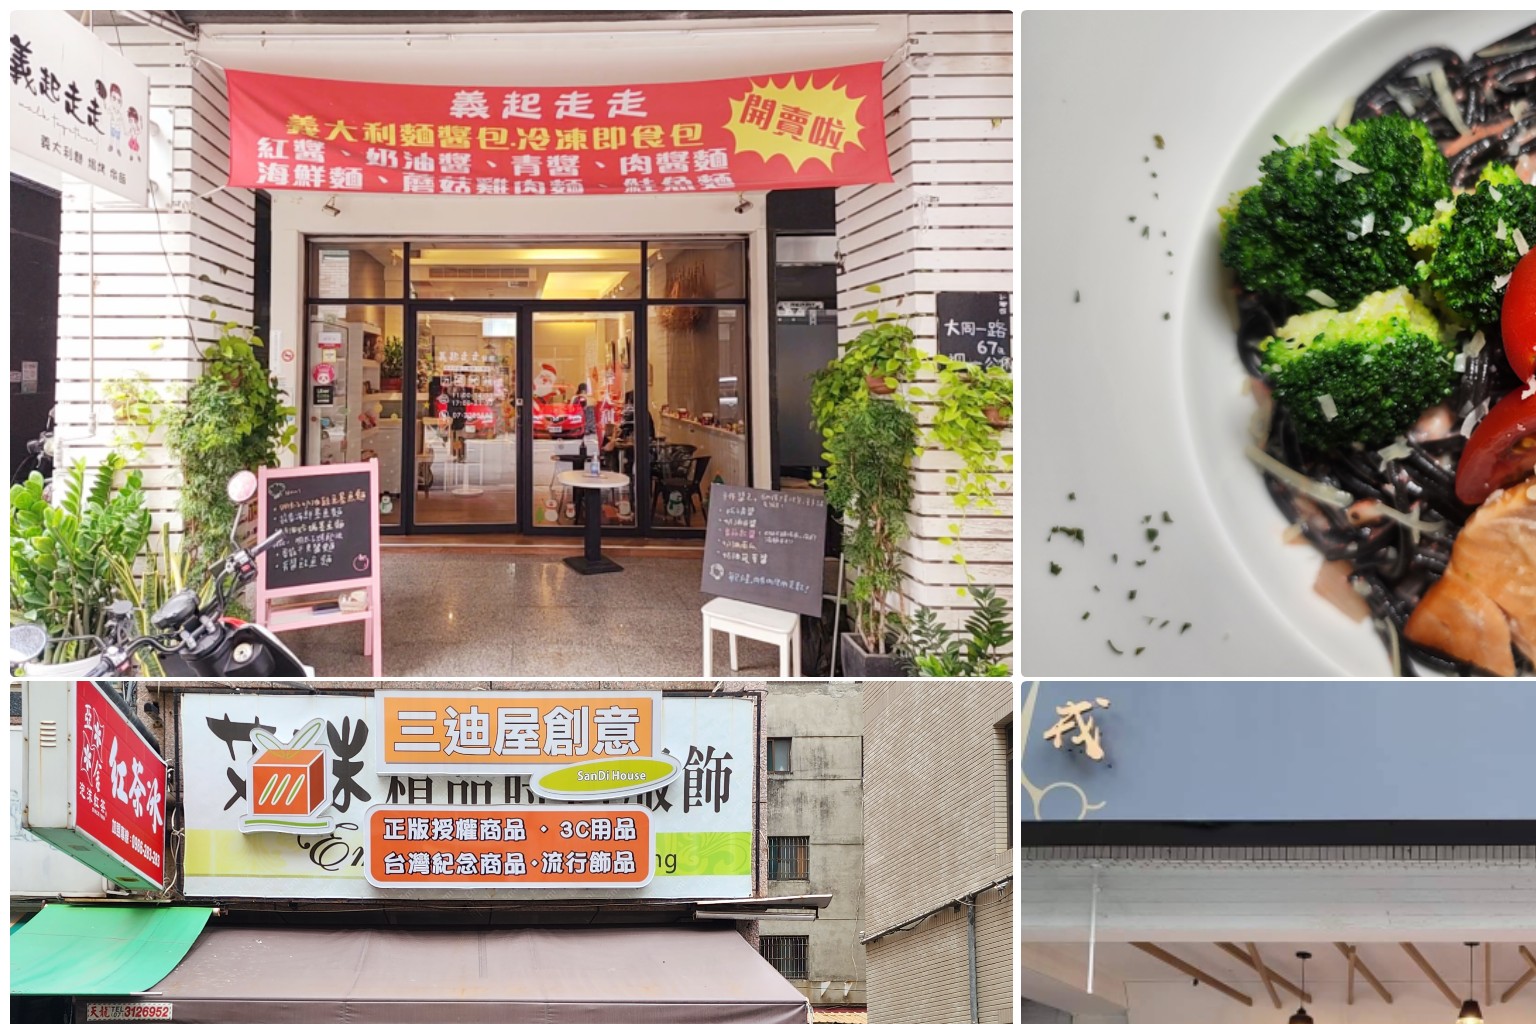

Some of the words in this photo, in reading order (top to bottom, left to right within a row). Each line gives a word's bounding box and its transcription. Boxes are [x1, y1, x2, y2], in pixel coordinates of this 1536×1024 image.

[449, 88, 648, 120] 義起走走
[738, 93, 847, 151] 開賣啦
[84, 704, 93, 731] 亞
[394, 705, 641, 757] 三迪屋創意
[109, 736, 164, 834] 紅茶冰
[577, 769, 610, 783] SanDi
[612, 768, 647, 782] House
[383, 817, 528, 842] 正版授權商品
[559, 817, 638, 842] 3C用品
[88, 1006, 110, 1018] 天龍
[124, 1006, 169, 1019] 3126952
